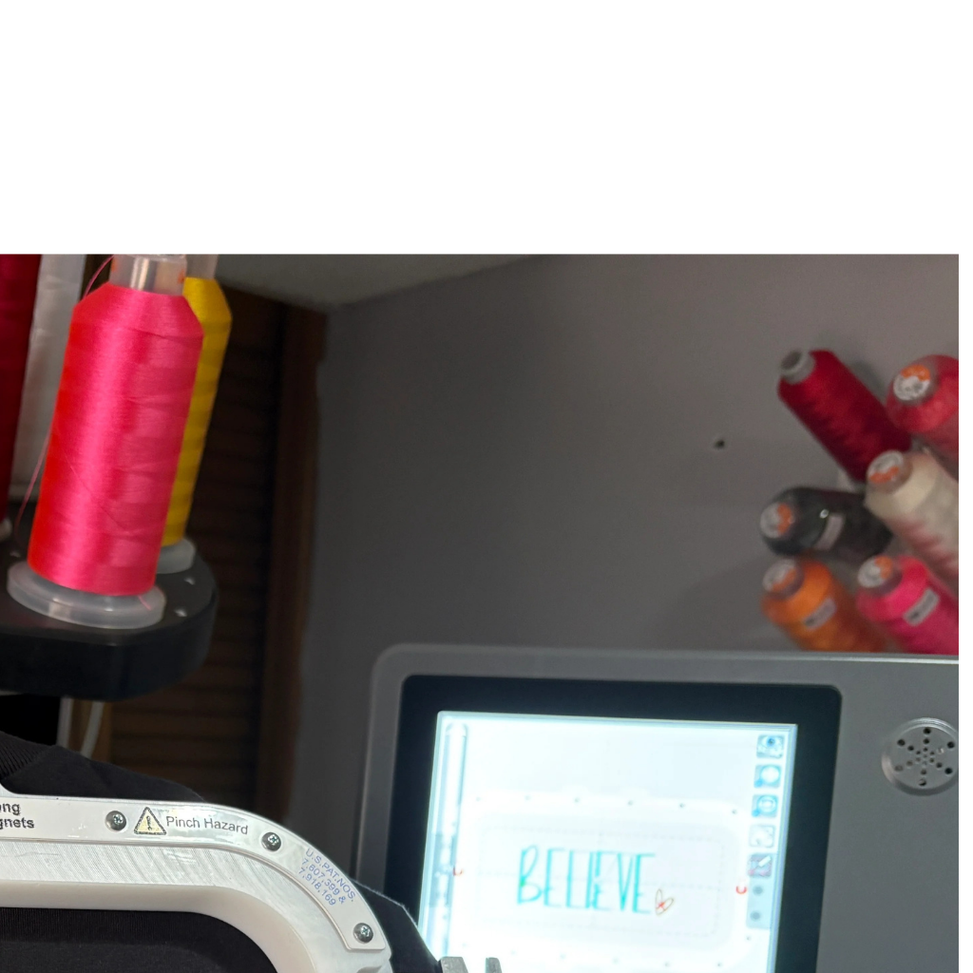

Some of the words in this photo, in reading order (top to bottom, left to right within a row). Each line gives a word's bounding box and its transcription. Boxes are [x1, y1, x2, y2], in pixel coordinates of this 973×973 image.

[166, 816, 201, 829] Pinch
[204, 818, 249, 835] Hazard
[517, 844, 656, 914] BELIEVE
[338, 895, 347, 905] &
